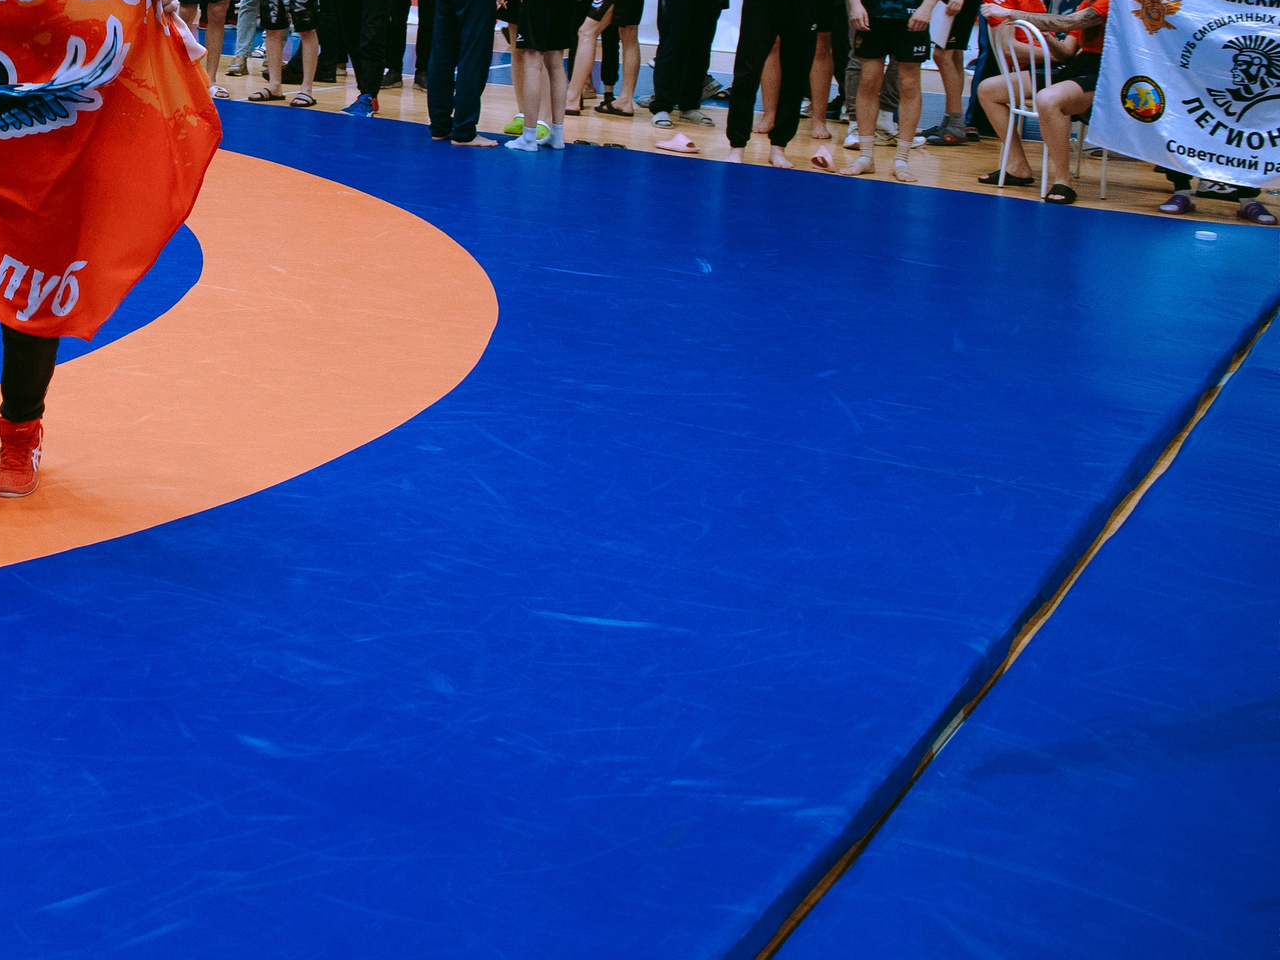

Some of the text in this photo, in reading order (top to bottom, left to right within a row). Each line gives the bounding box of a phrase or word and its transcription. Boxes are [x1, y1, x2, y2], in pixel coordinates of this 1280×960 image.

[1180, 12, 1277, 70] КЛУБ СМЕШАННЫХ
[1166, 139, 1259, 171] Советский
